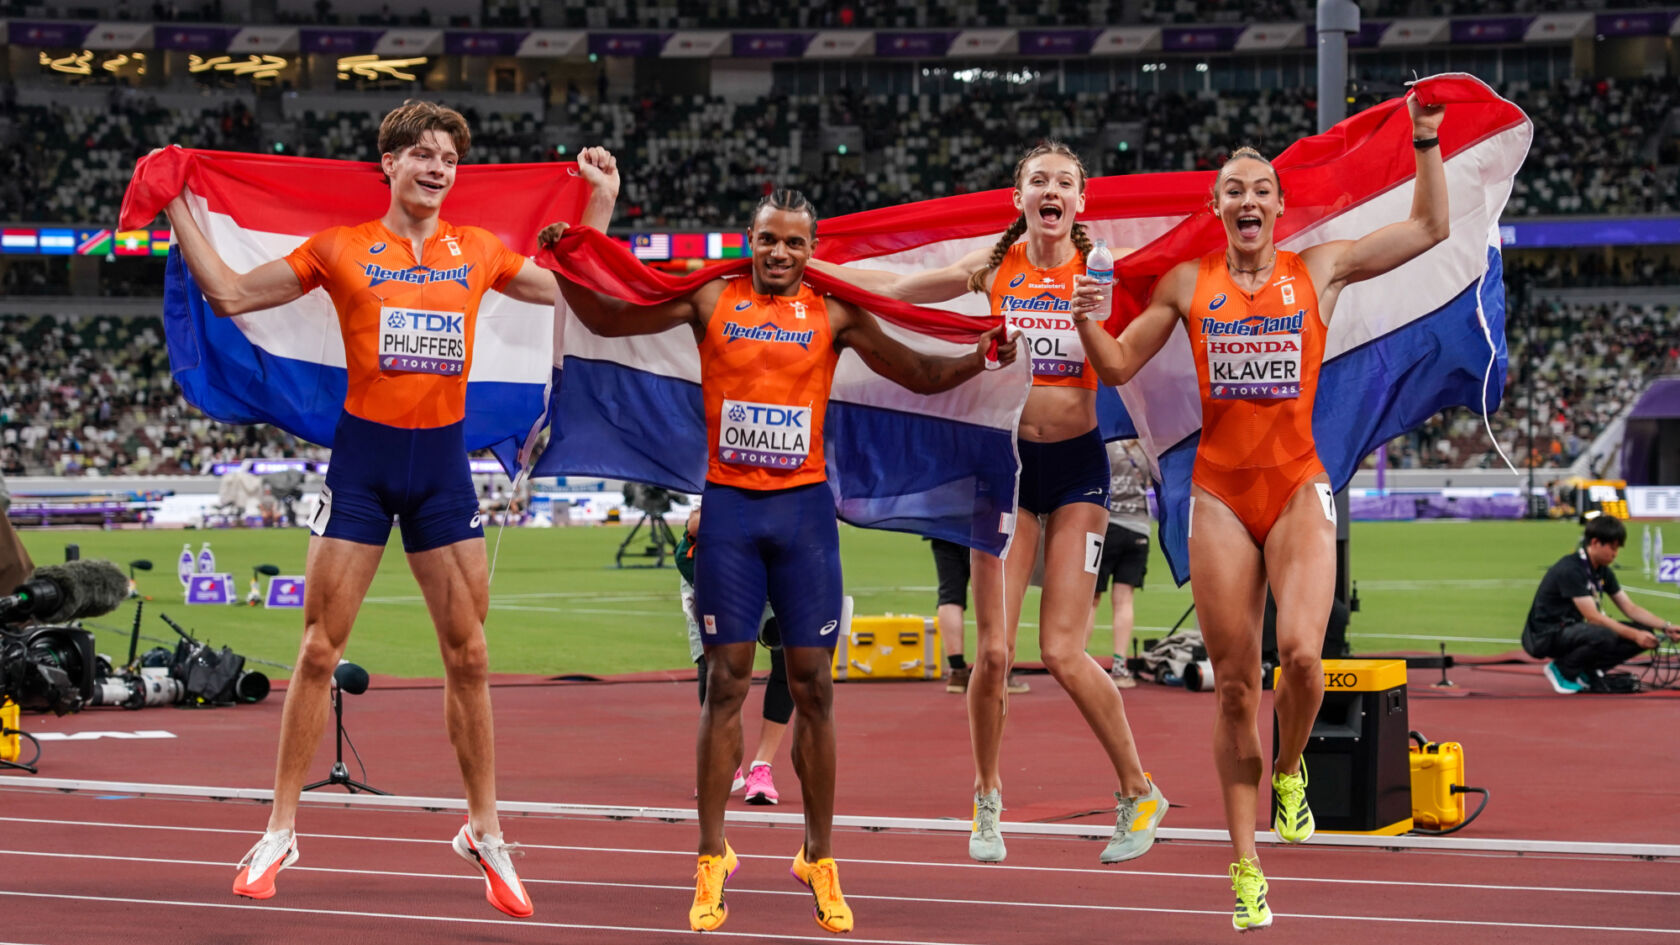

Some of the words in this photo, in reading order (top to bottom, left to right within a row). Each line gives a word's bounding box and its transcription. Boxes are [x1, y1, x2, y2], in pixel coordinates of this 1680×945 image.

[365, 263, 468, 285] Nederland
[1000, 295, 1072, 311] Nederla
[406, 312, 463, 334] TDK
[722, 321, 815, 344] Nederland
[1201, 309, 1304, 336] Nederland
[384, 333, 463, 358] PHIJFFERS
[1209, 340, 1299, 354] HONDA
[1213, 360, 1297, 380] KLAVER
[746, 406, 804, 428] TDK
[725, 426, 805, 452] OMALLA
[1093, 540, 1103, 568] 7
